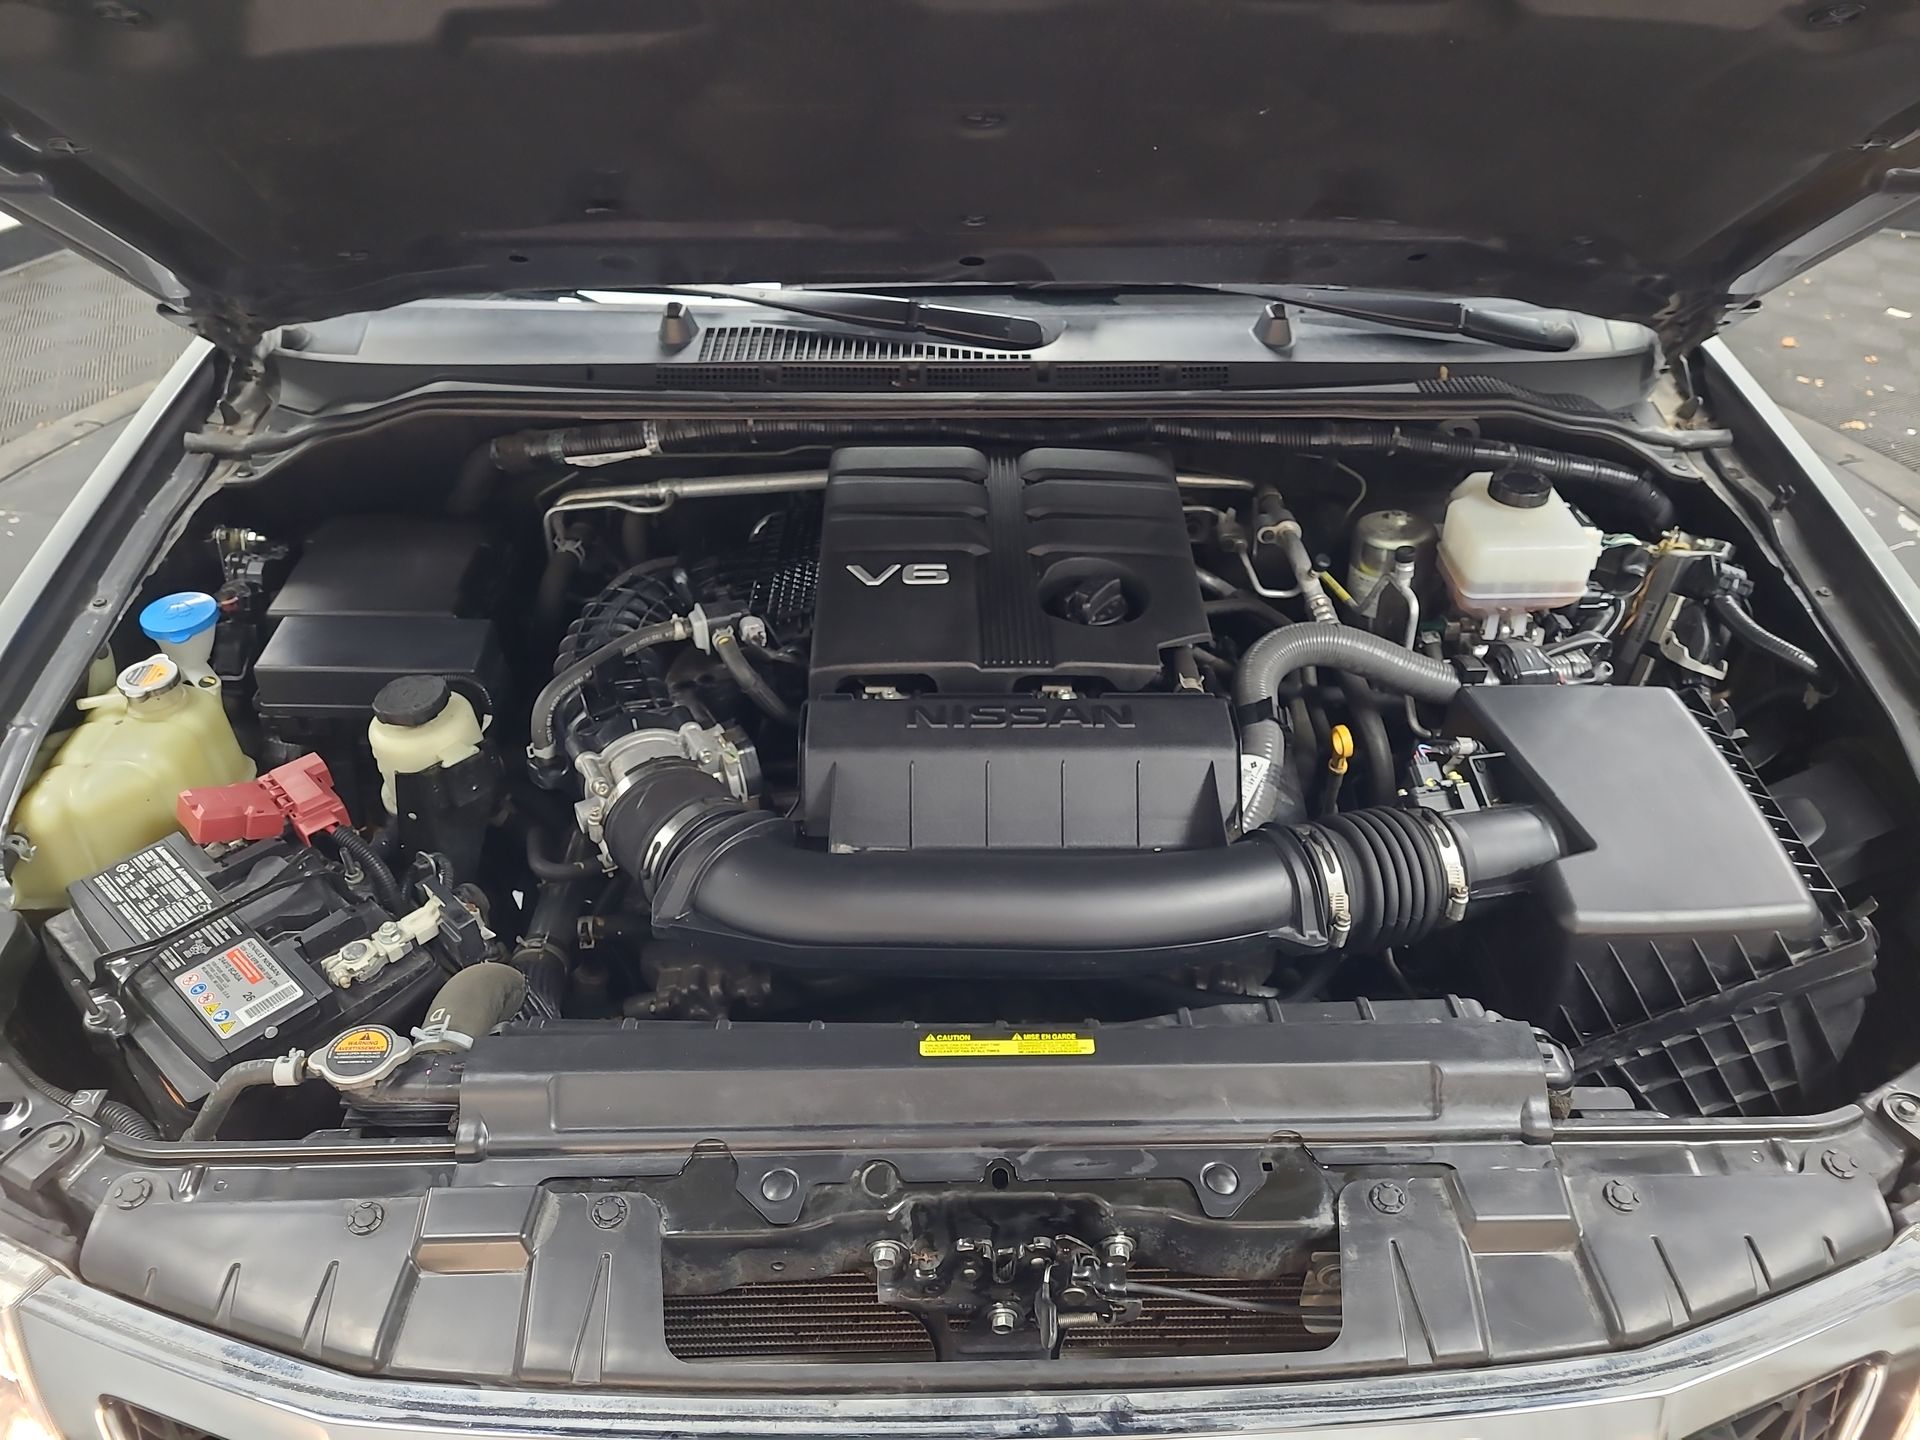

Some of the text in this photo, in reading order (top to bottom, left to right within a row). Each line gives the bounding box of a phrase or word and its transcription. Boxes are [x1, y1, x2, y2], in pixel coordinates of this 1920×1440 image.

[846, 563, 950, 586] V6
[906, 705, 1136, 729] NISSAN
[263, 957, 280, 977] NISSAN
[242, 991, 256, 1002] 26
